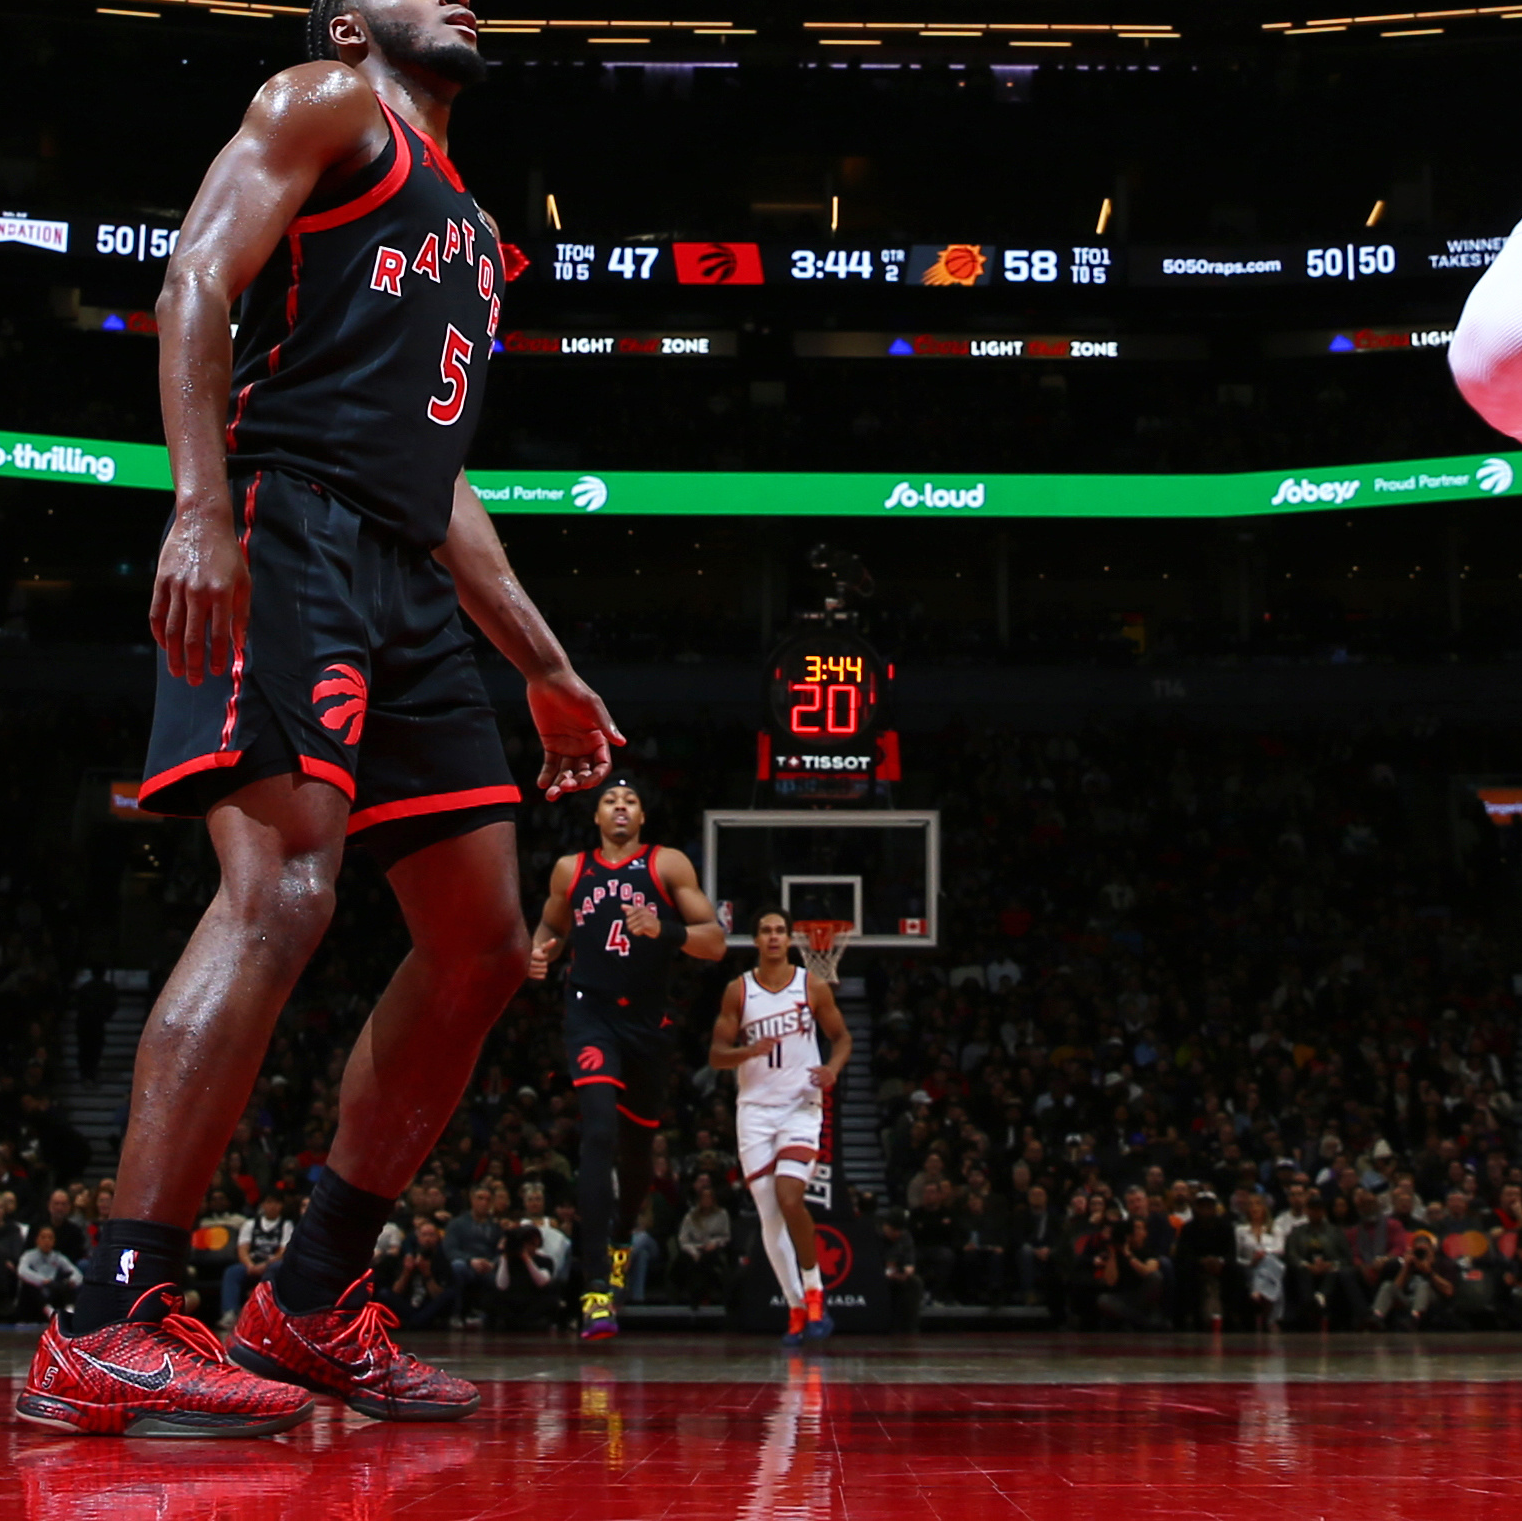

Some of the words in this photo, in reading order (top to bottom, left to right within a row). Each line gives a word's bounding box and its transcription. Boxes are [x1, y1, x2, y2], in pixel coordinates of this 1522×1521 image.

[1447, 236, 1510, 253] WINNE
[607, 247, 659, 279] 47
[791, 250, 873, 279] 3:44
[880, 249, 905, 264] QTR
[1429, 253, 1478, 268] TAKES
[554, 262, 573, 280] TO
[576, 264, 589, 280] 5
[885, 265, 899, 282] 2
[1004, 250, 1058, 282] 58
[1070, 266, 1089, 283] TO
[1092, 268, 1107, 283] 5
[1163, 258, 1281, 276] 5050raps.com
[370, 218, 500, 343] RAPTOR
[561, 337, 615, 354] LIGHT
[661, 337, 710, 354] ZONE
[1411, 332, 1458, 346] LIGH
[970, 340, 1024, 357] LIGHT
[1070, 341, 1118, 357] ZONE
[427, 323, 474, 425] 5
[514, 486, 565, 501] Partner
[1271, 478, 1360, 505] Sobeys
[1374, 476, 1415, 492] Proud
[1419, 474, 1470, 488] Partner
[805, 656, 862, 683] 3:44
[791, 684, 856, 733] 20
[802, 755, 871, 770] TISSOT
[605, 919, 630, 956] 4
[768, 1041, 781, 1068] 11
[42, 1366, 58, 1390] 5
